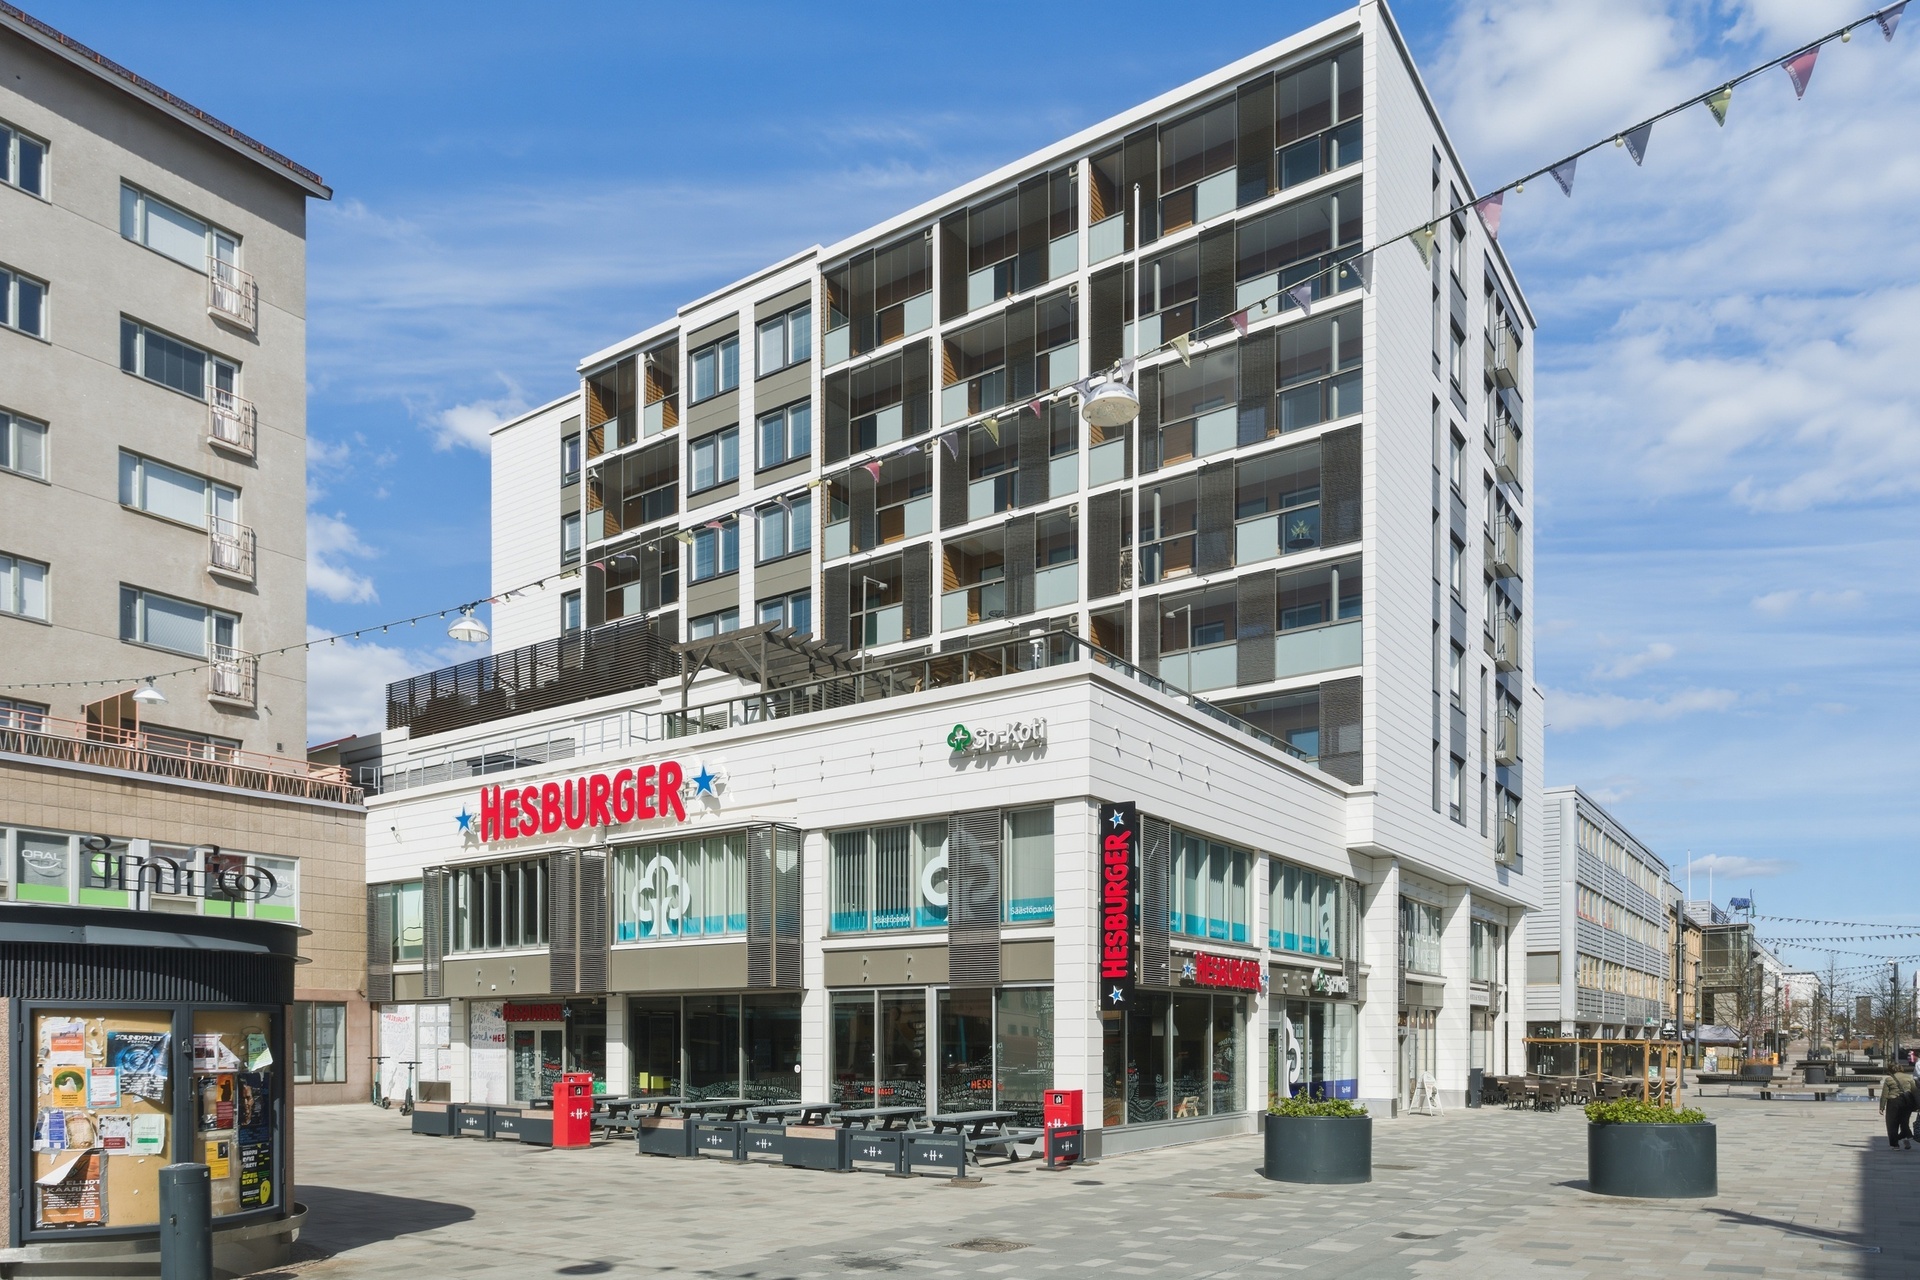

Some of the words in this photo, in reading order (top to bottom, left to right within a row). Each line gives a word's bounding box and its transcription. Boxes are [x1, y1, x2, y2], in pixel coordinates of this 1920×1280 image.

[972, 717, 1047, 752] Sp-Koti
[481, 760, 686, 843] HESBURGER
[22, 849, 62, 861] ORAL
[83, 834, 277, 900] info
[1011, 904, 1054, 915] Säästöpankk
[1102, 830, 1132, 978] HESBURGER
[1196, 950, 1262, 993] HESBURGER
